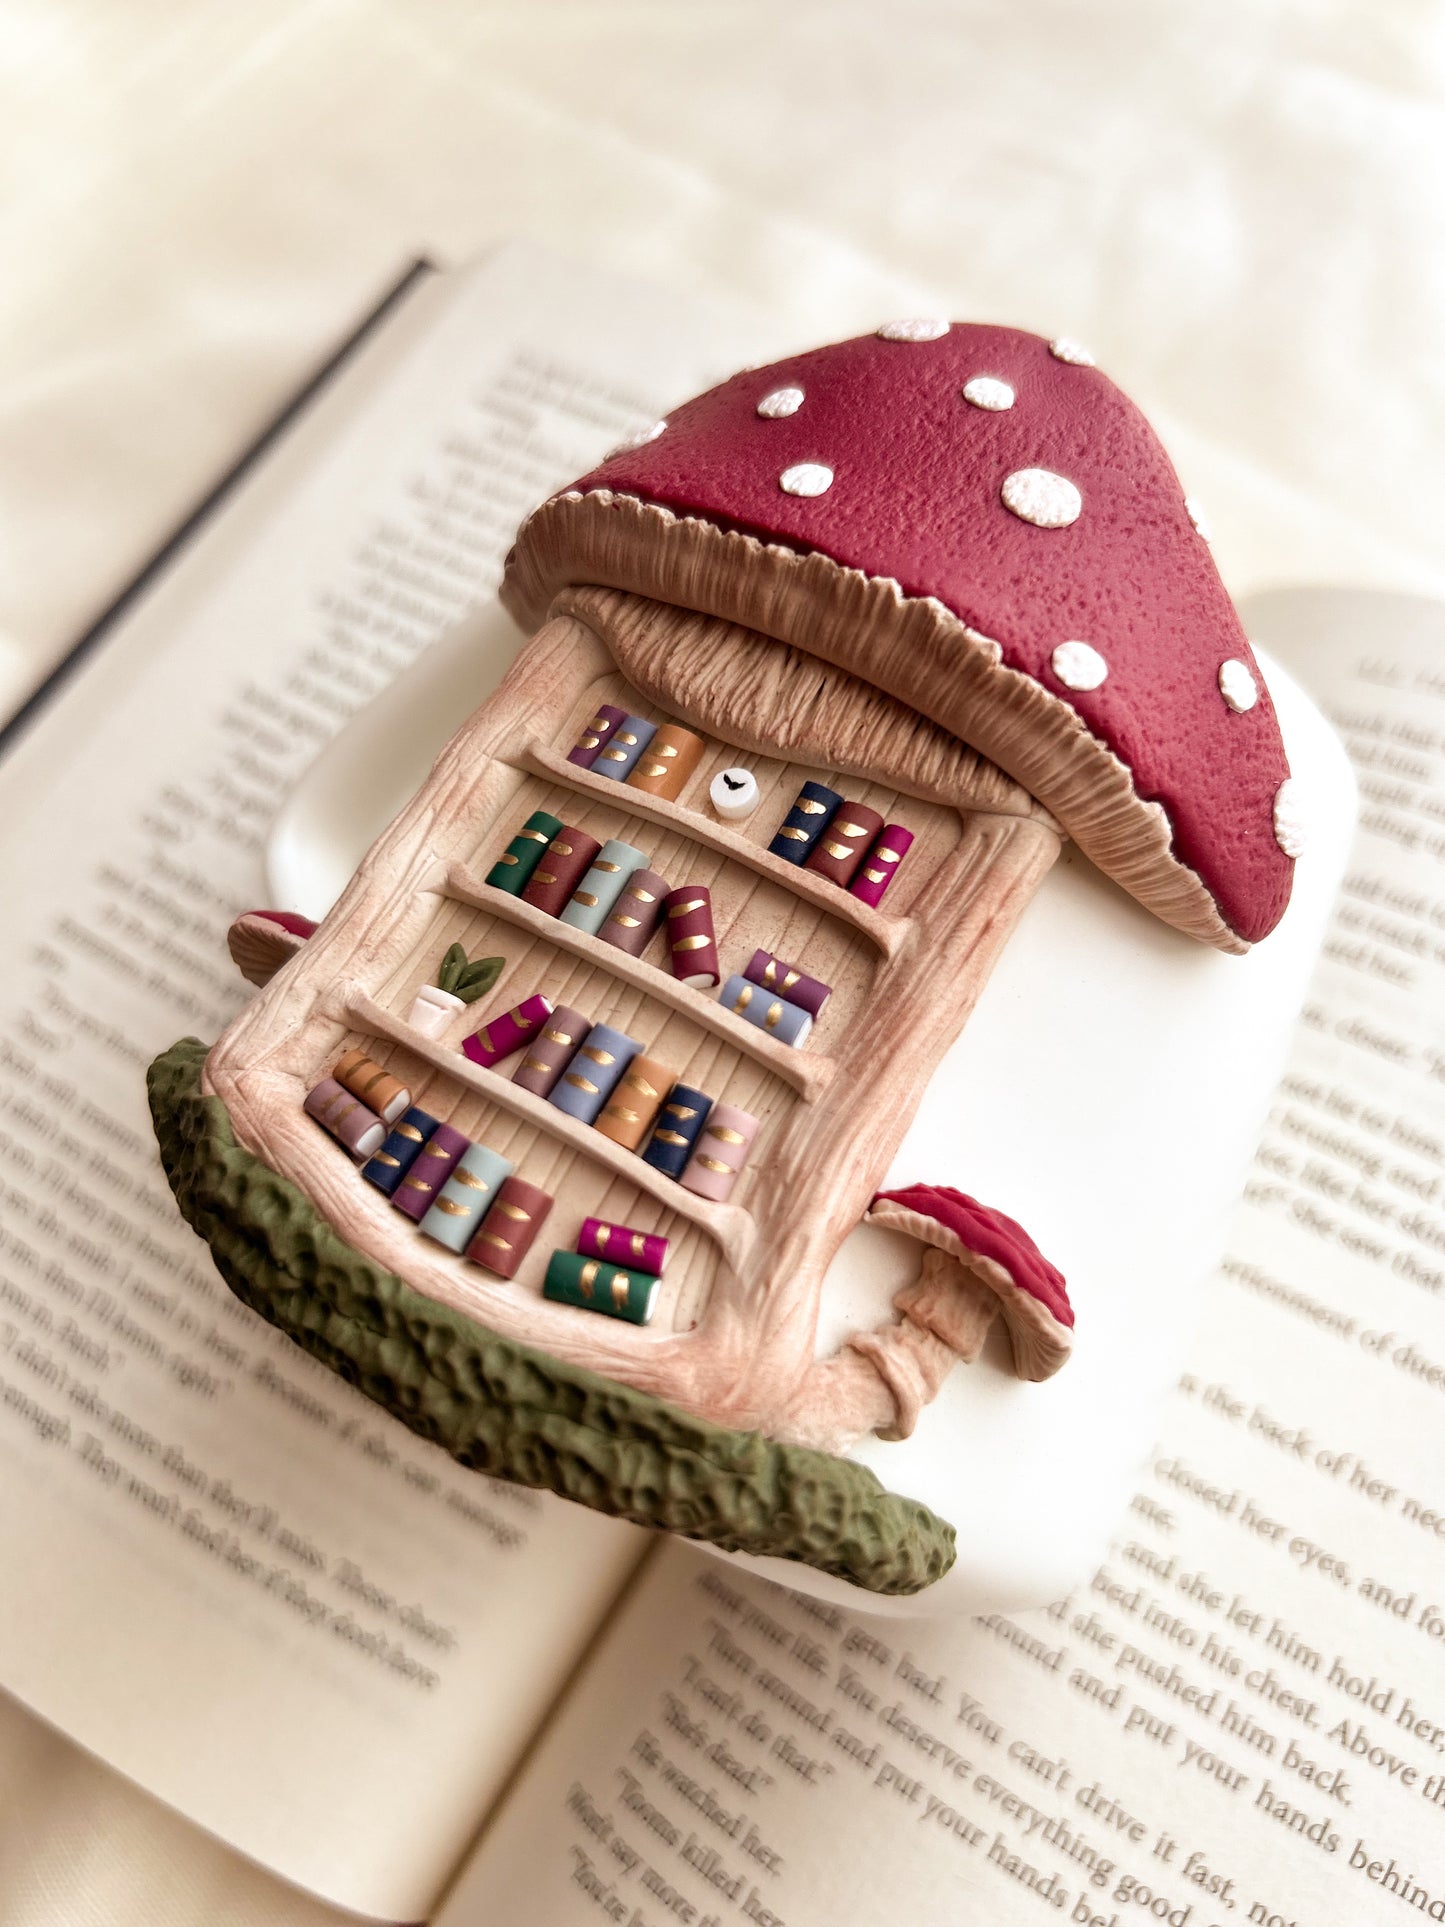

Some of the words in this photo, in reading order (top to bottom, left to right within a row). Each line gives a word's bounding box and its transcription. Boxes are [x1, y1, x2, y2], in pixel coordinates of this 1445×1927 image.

[1248, 1405, 1312, 1458] back
[1315, 1450, 1354, 1477] of
[1350, 1460, 1398, 1503] her
[1122, 1541, 1180, 1581] and
[1176, 1571, 1225, 1609] she
[1225, 1595, 1264, 1634] let
[1265, 1618, 1322, 1673] him
[1327, 1655, 1396, 1714] hold
[1396, 1698, 1445, 1752] her,
[1240, 1499, 1288, 1542] her
[1288, 1537, 1351, 1587] eyes,
[1358, 1577, 1418, 1618] and
[1417, 1604, 1445, 1644] fo
[738, 1710, 772, 1742] do
[836, 1665, 879, 1711] You
[879, 1702, 974, 1777] deserve
[973, 1774, 1115, 1886] everything
[1069, 1667, 1125, 1709] and
[1123, 1703, 1178, 1746] put
[1178, 1739, 1250, 1790] your
[1255, 1778, 1341, 1852] hands
[1071, 1612, 1117, 1648] she
[1115, 1644, 1220, 1715] pushed
[1220, 1700, 1277, 1755] him
[1282, 1738, 1352, 1806] back.
[1143, 1600, 1198, 1646] into
[1201, 1633, 1243, 1676] his
[1244, 1668, 1319, 1728] chest.
[1327, 1718, 1418, 1784] Above
[679, 1832, 747, 1901] killed
[753, 1669, 837, 1734] around
[831, 1727, 884, 1769] and
[873, 1761, 925, 1804] put
[919, 1794, 988, 1848] your
[987, 1831, 1069, 1908] hands
[957, 1692, 1003, 1745] You
[1008, 1740, 1073, 1791] can't
[1074, 1782, 1147, 1841] drive
[1153, 1831, 1179, 1862] it
[1182, 1851, 1236, 1909] fast,
[1247, 1901, 1298, 1927] no
[641, 1865, 698, 1923] more
